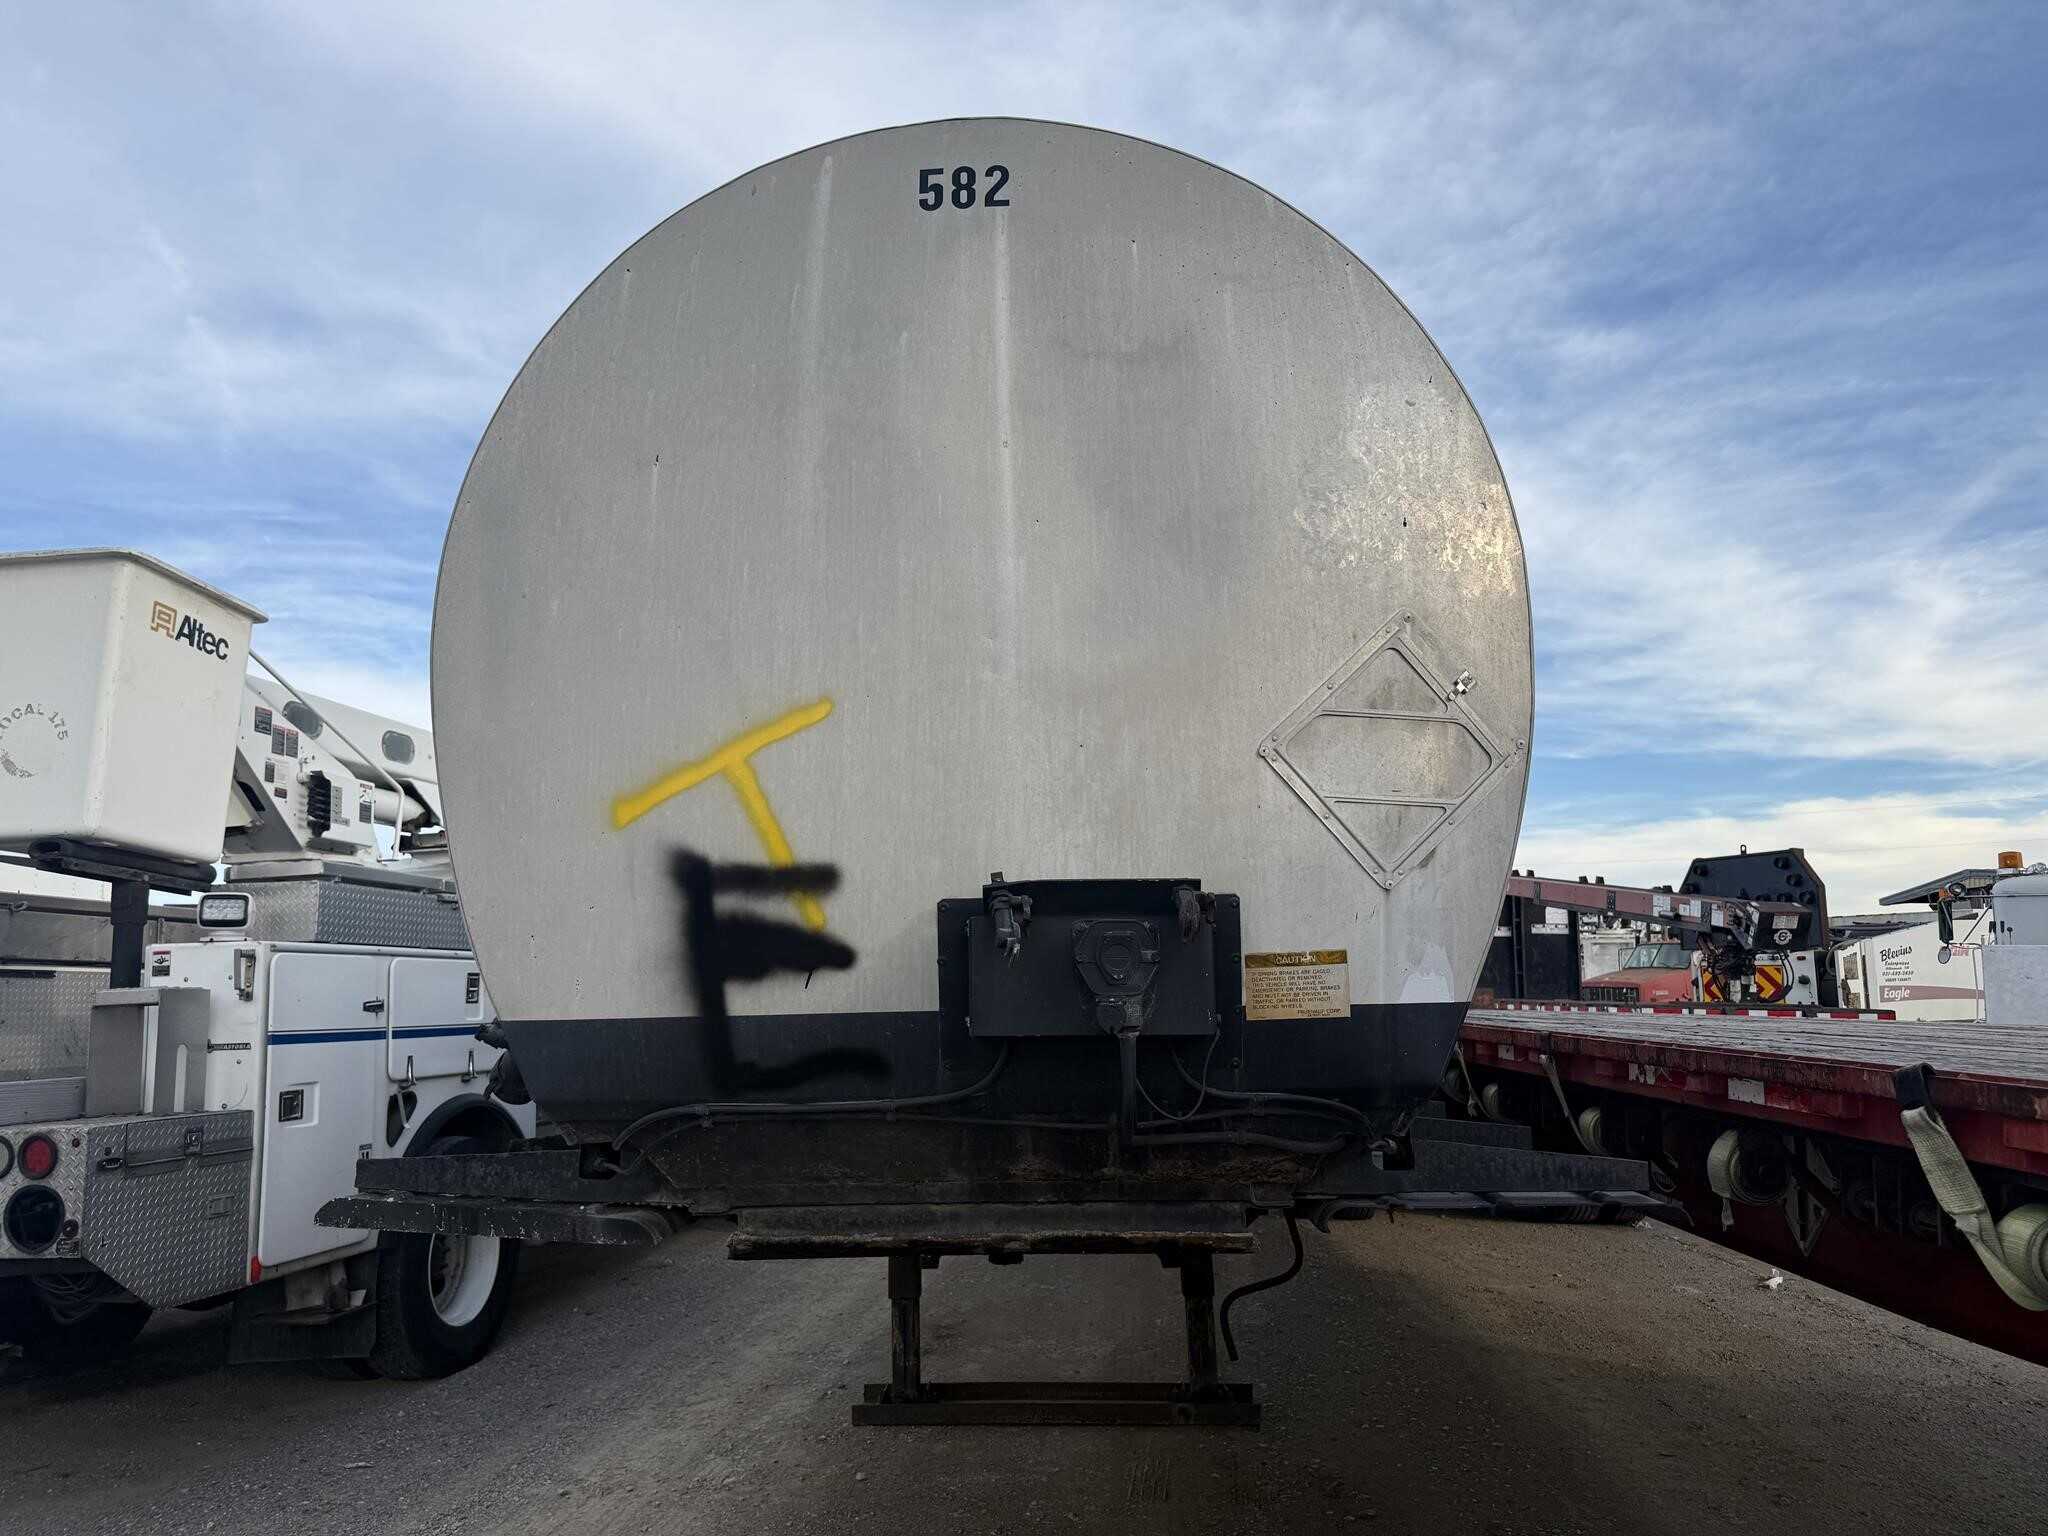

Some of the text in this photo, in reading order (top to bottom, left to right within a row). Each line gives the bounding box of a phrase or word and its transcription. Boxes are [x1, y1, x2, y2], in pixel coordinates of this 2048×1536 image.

[919, 165, 1010, 211] 582
[175, 614, 229, 661] Altec
[1880, 945, 1912, 962] Blevins
[1884, 987, 1910, 1001] Eagle
